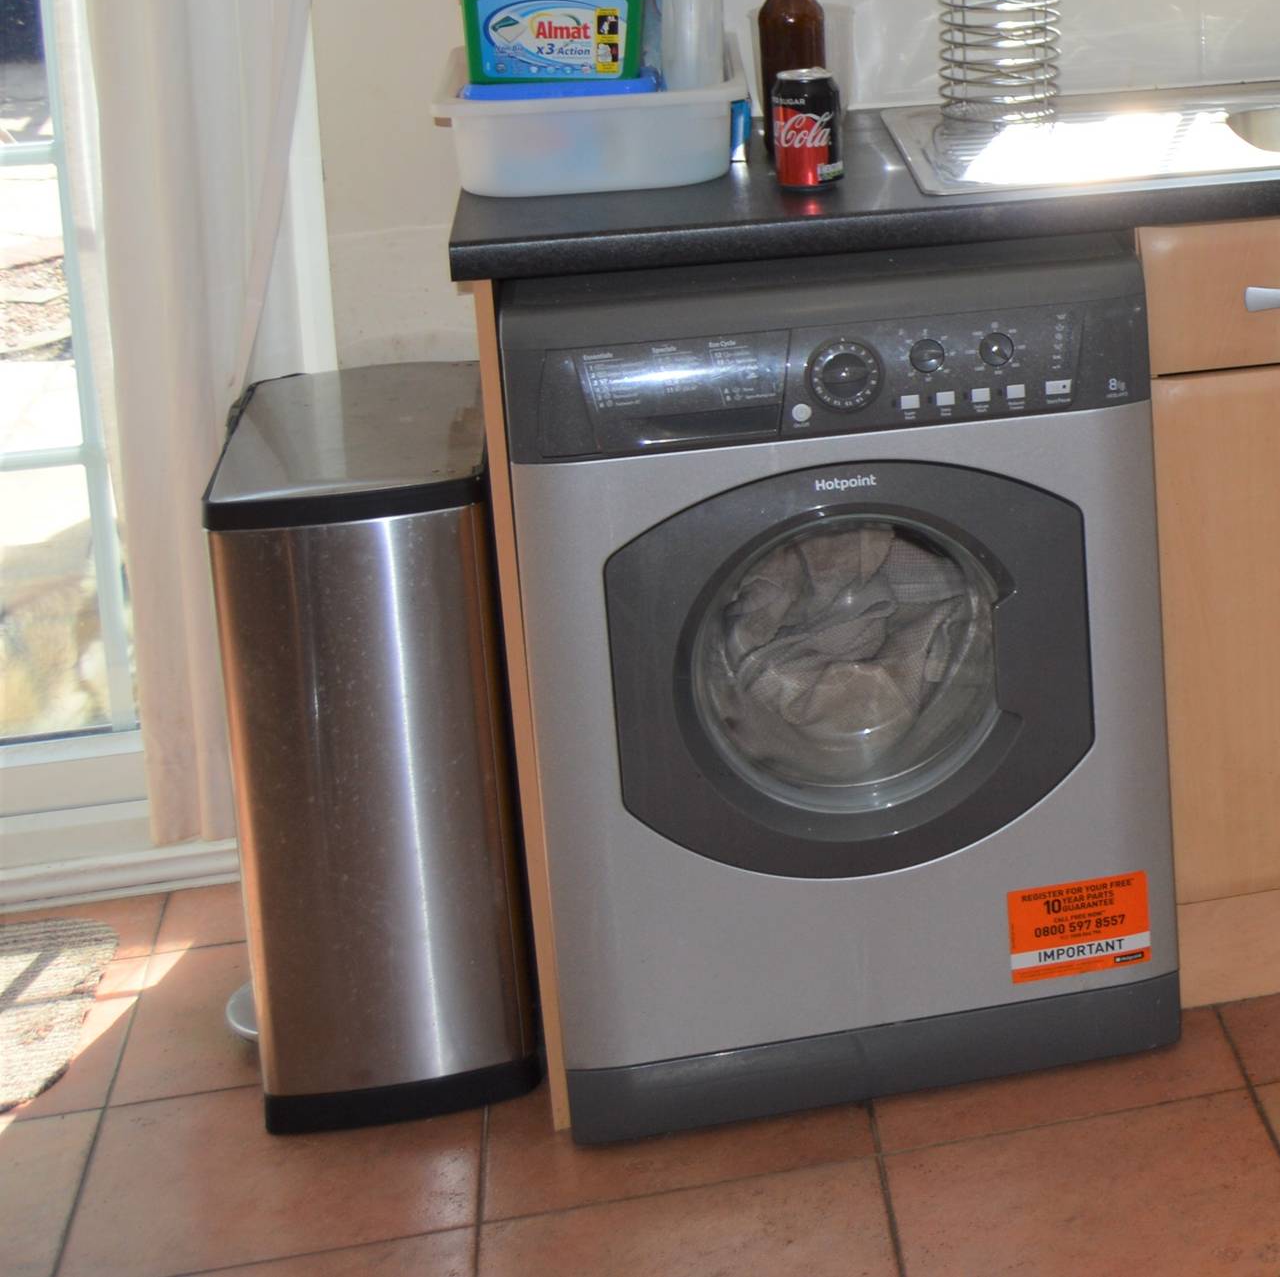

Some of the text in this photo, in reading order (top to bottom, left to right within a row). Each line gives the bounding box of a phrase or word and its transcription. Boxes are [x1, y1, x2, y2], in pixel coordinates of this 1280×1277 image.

[536, 21, 591, 40] Almat
[557, 46, 590, 55] Action
[781, 111, 833, 148] Cola
[815, 474, 877, 491] Hotpoint
[1021, 889, 1064, 902] REGISTER
[1066, 887, 1083, 896] FOR
[1085, 883, 1108, 893] YOUR
[1043, 890, 1114, 915] 10 YEAR PARTS
[1062, 899, 1114, 912] GUARANTEE
[1034, 923, 1065, 938] 0800
[1069, 920, 1091, 932] 597
[1095, 914, 1126, 928] 8557
[1038, 938, 1125, 963] IMPORTANT
